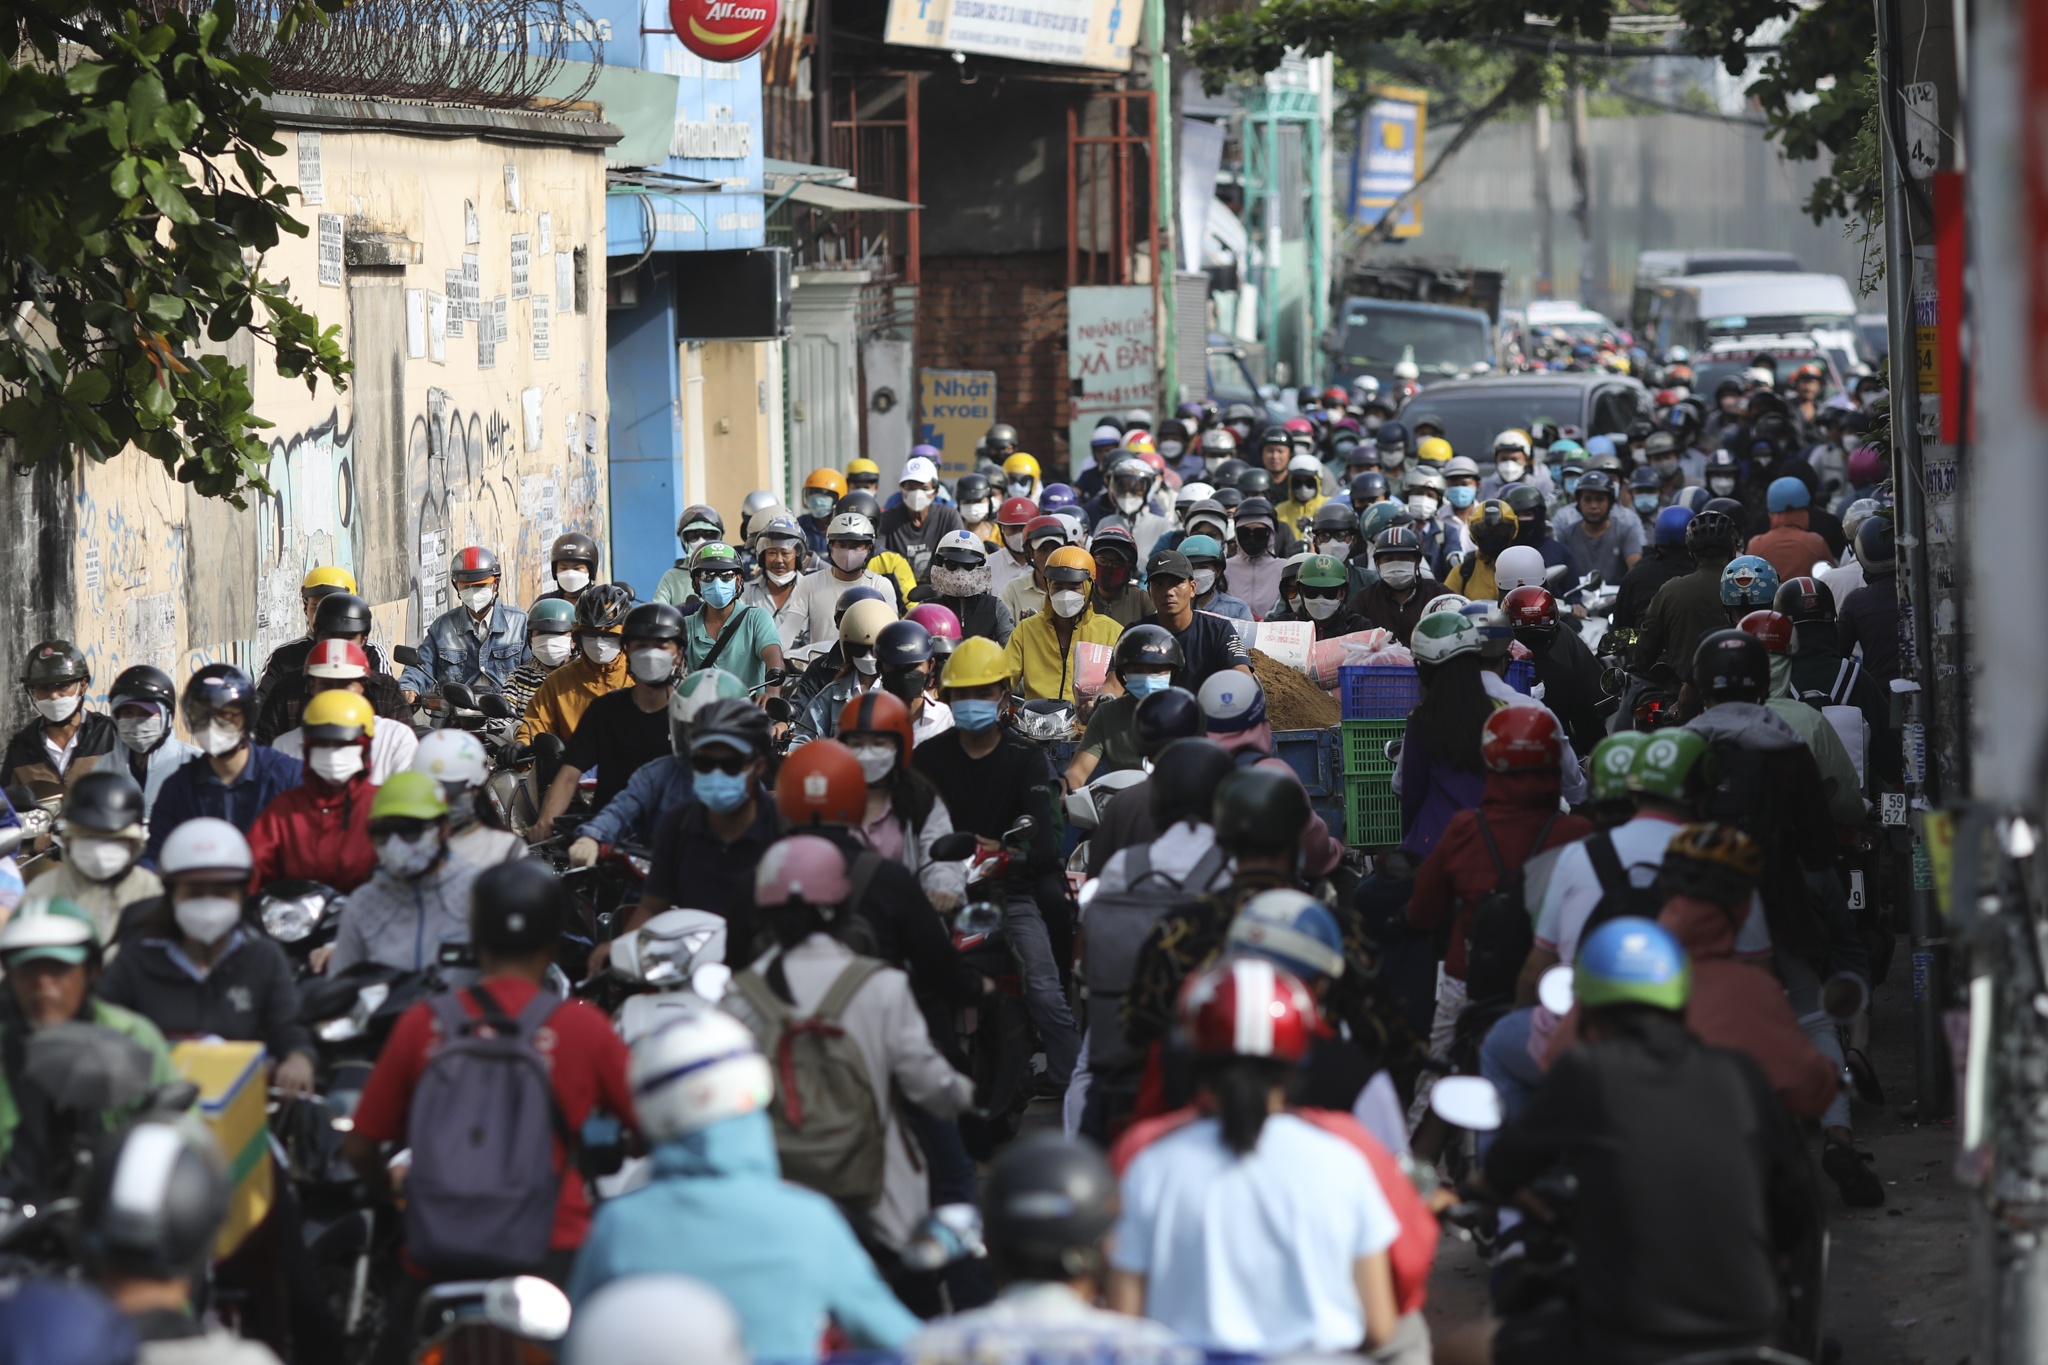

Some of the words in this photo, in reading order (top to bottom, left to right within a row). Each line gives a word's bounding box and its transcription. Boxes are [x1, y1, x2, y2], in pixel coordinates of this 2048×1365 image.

[934, 379, 989, 401] Nhật
[933, 405, 988, 418] KYOEI
[1889, 794, 1904, 809] 59
